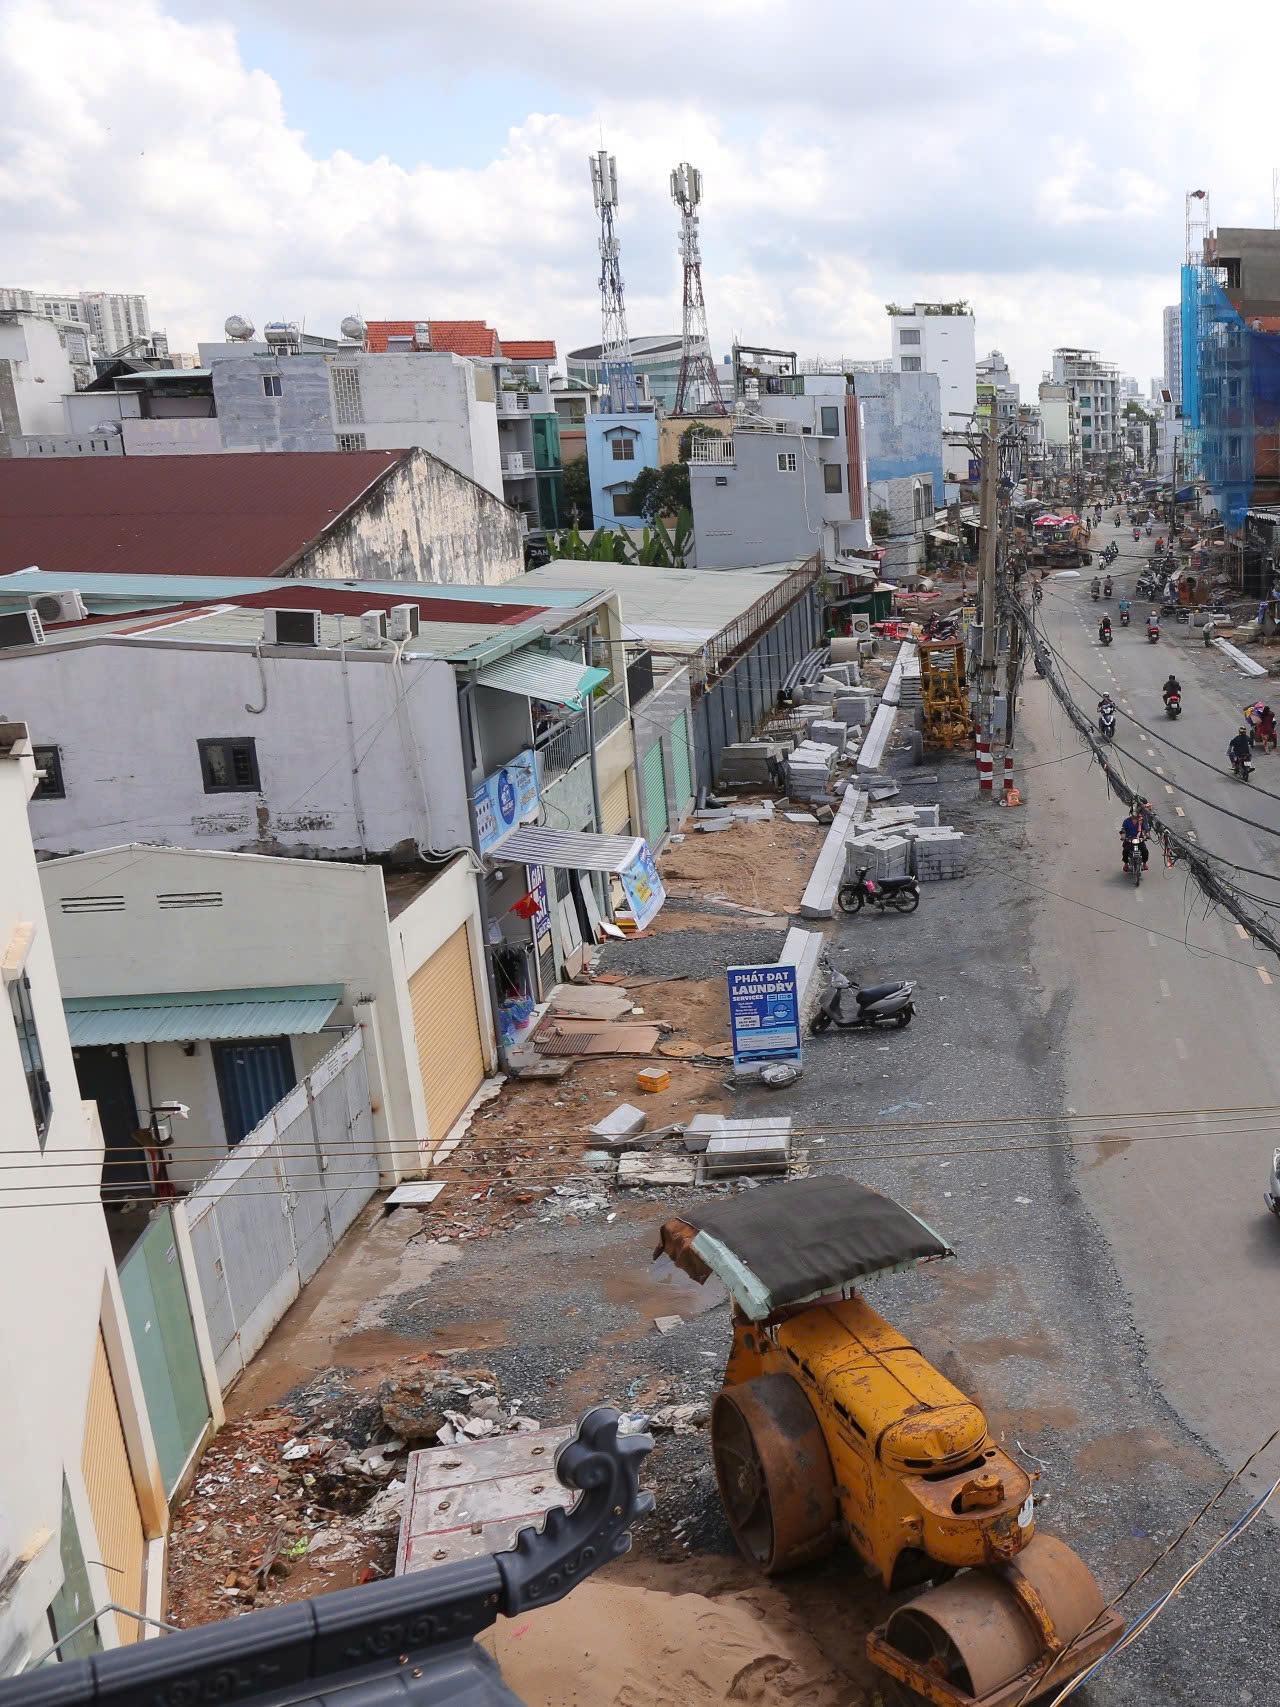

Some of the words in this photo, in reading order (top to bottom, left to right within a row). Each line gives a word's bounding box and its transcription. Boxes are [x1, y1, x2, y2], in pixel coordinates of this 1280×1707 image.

[735, 971, 764, 983] PHÁT
[766, 971, 789, 983] ĐẠT
[732, 982, 794, 995] LAUNDRY
